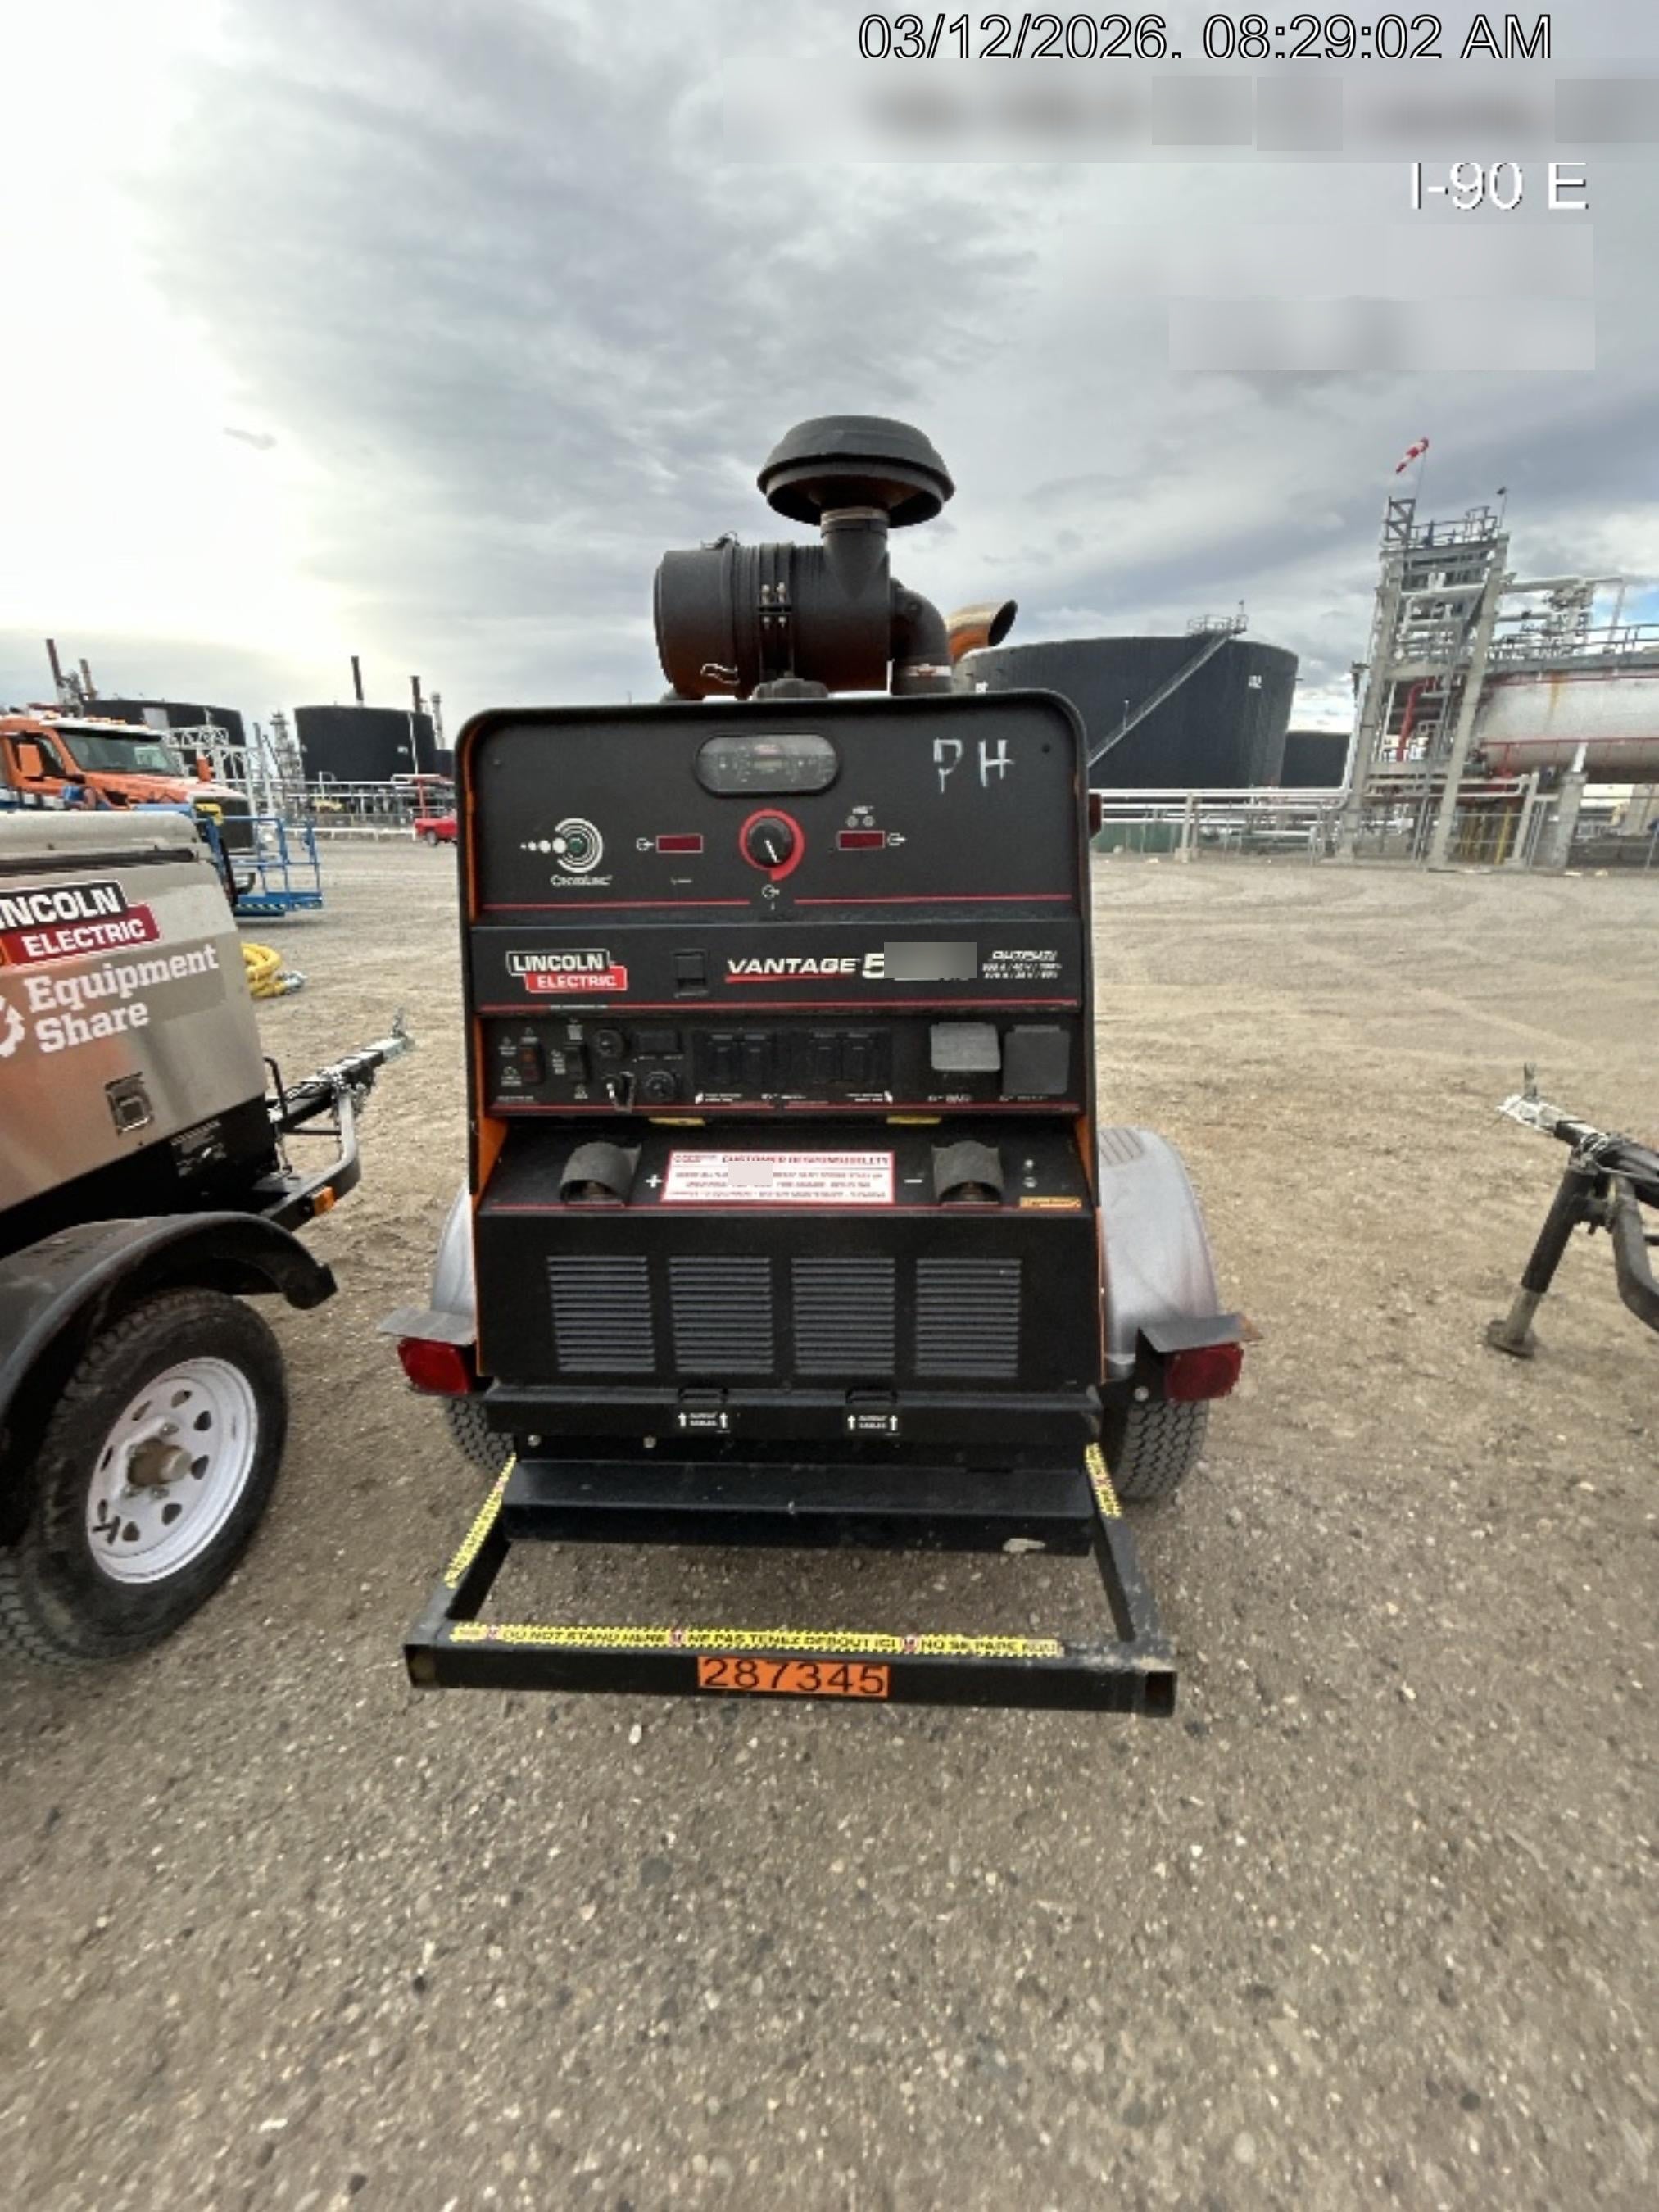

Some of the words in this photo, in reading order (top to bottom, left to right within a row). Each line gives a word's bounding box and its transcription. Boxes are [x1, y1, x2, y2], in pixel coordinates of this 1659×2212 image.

[0, 886, 122, 929] NCOLN
[21, 918, 146, 958] ELECTRIC
[512, 953, 604, 972] LINCOLN
[728, 957, 857, 975] VANTAGE
[23, 943, 220, 1013] Equipment
[537, 974, 617, 989] ELECTRIC
[35, 1002, 150, 1054] Share
[504, 1630, 527, 1640] DO
[530, 1630, 561, 1640] NOT
[566, 1631, 620, 1642] STAND
[622, 1632, 666, 1643] HERE
[714, 1633, 745, 1643] PAS
[874, 1638, 896, 1648] ICI
[922, 1639, 945, 1650] NO
[703, 1658, 884, 1694] 287345
